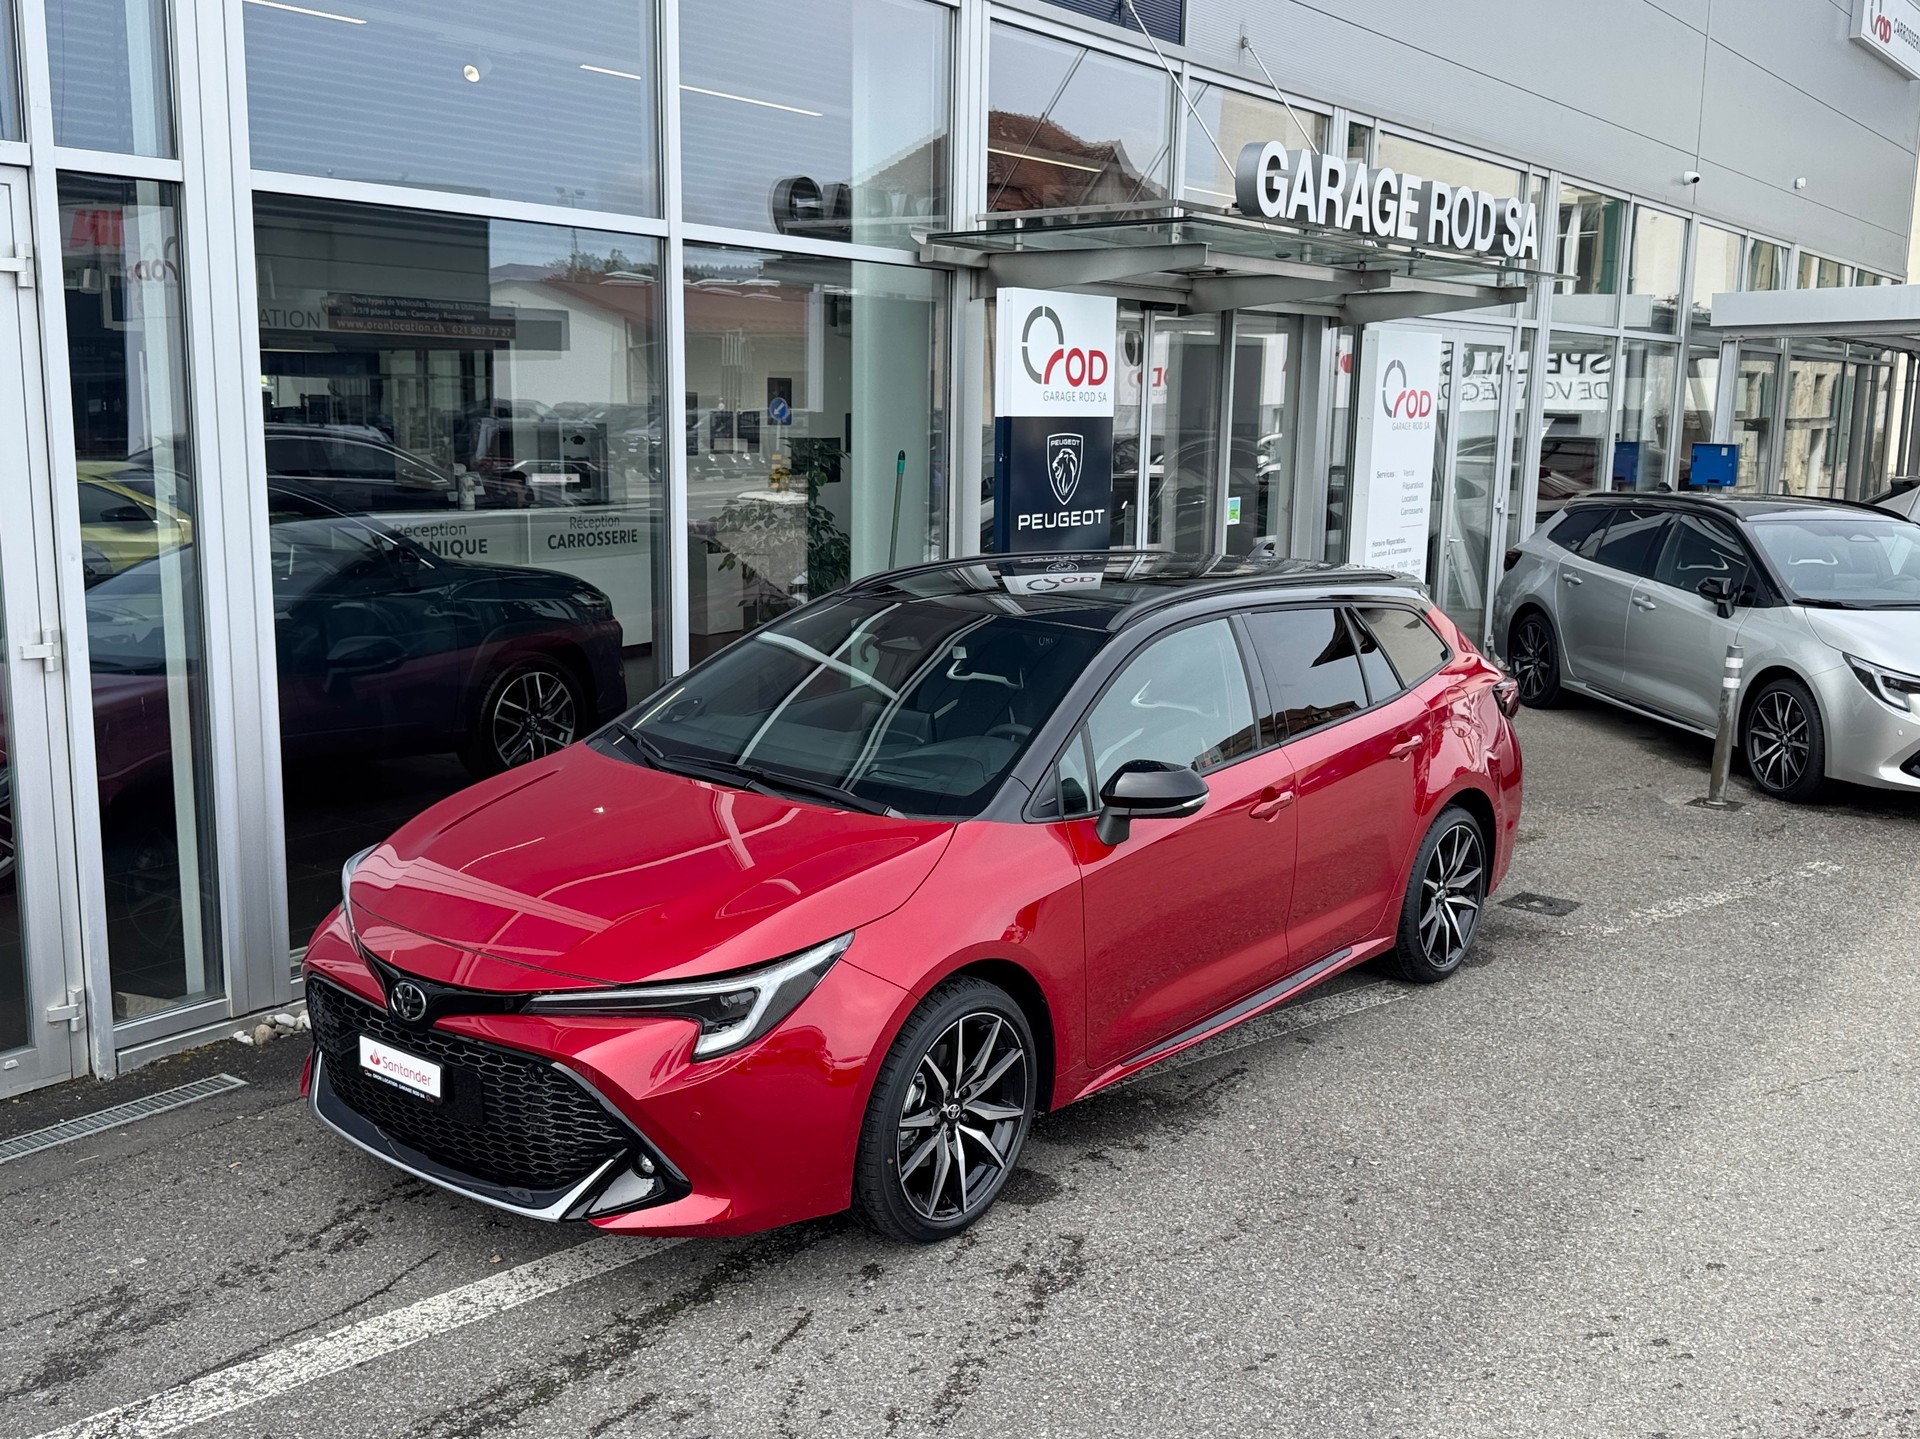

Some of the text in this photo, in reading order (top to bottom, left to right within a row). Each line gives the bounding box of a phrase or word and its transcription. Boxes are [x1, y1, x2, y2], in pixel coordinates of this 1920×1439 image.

[1256, 140, 1538, 260] GARAGE ROD SA
[337, 319, 445, 333] www.oronlocation.ch
[452, 325, 468, 335] 021
[471, 326, 486, 335] 907
[489, 327, 499, 336] 77
[1043, 390, 1108, 403] GARAGE ROD SA
[1392, 421, 1412, 431] GARAGE
[1050, 438, 1080, 447] PEUGEOT
[569, 515, 620, 532] Réception
[1018, 509, 1105, 530] PEUGEOT
[394, 521, 467, 540] Réception
[547, 529, 638, 550] CARROSSERIE
[382, 1056, 432, 1086] Santander
